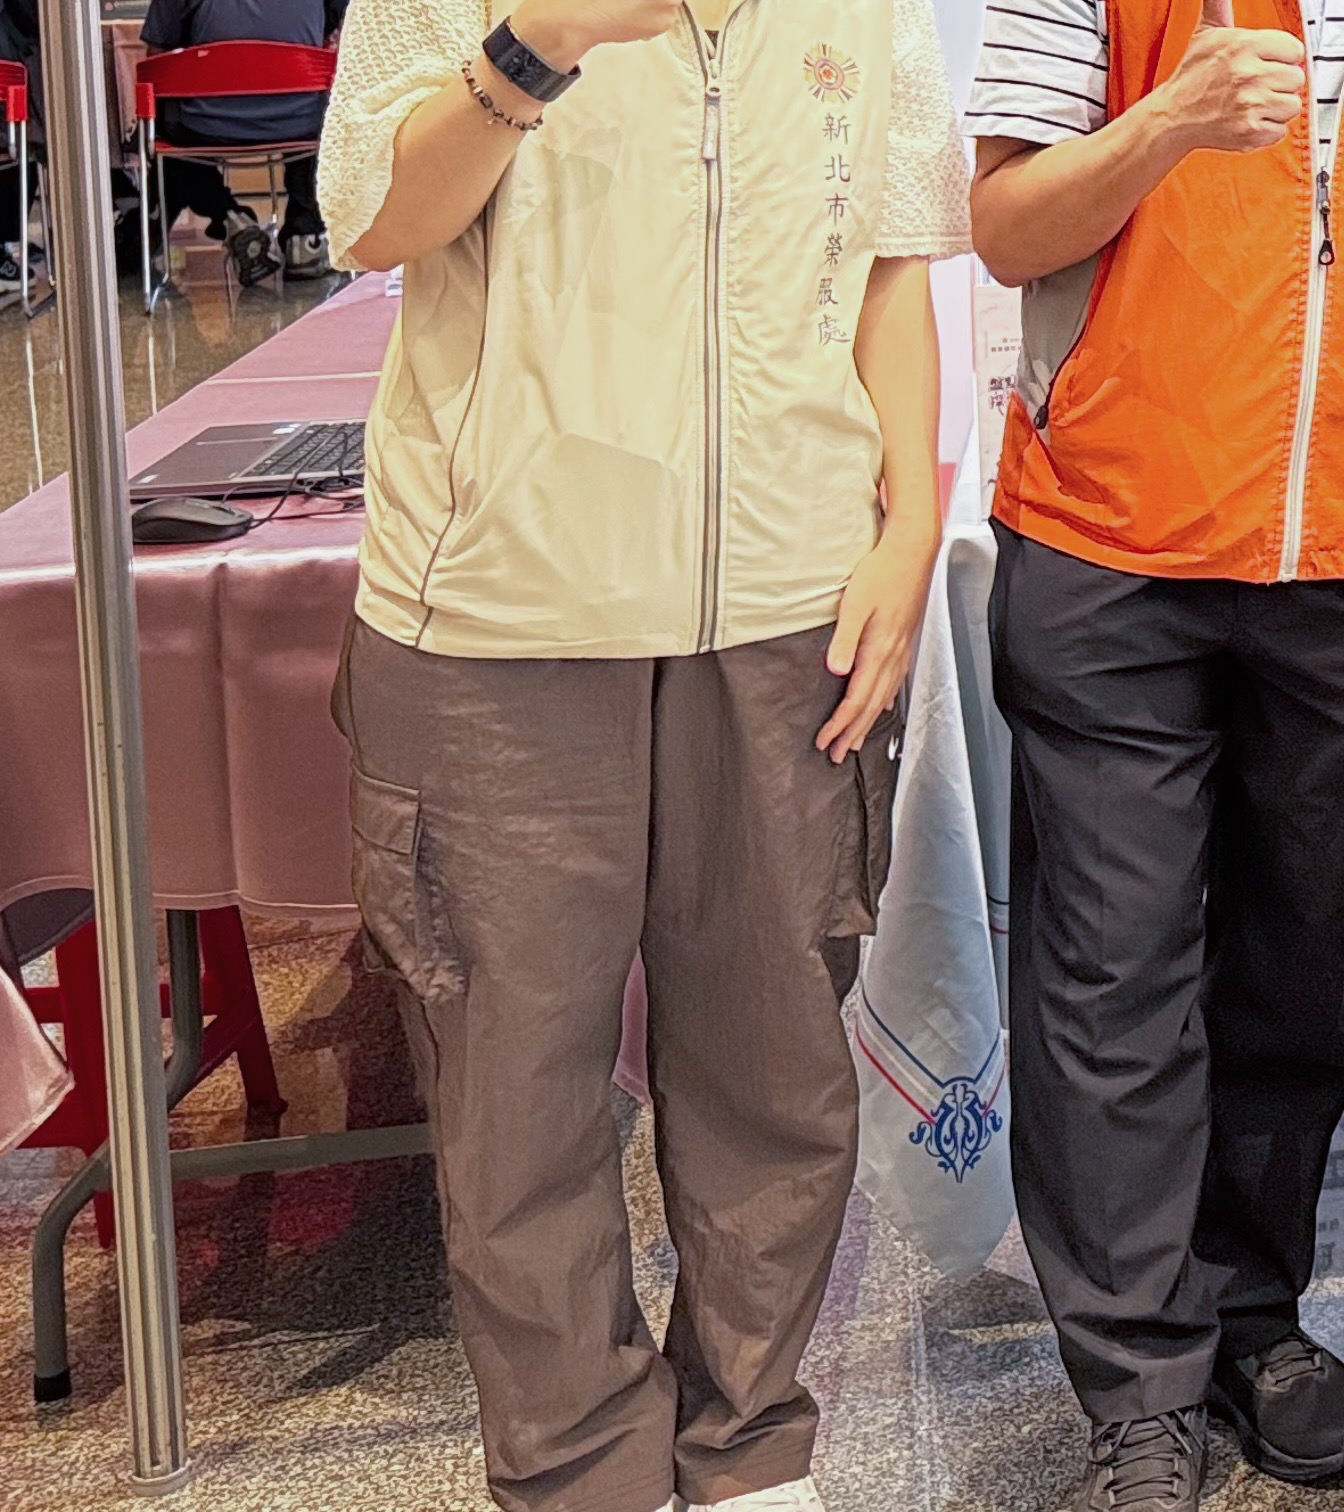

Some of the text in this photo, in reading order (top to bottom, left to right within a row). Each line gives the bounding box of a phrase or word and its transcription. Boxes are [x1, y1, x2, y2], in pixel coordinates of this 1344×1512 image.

[814, 112, 852, 347] 新北市榮服處
